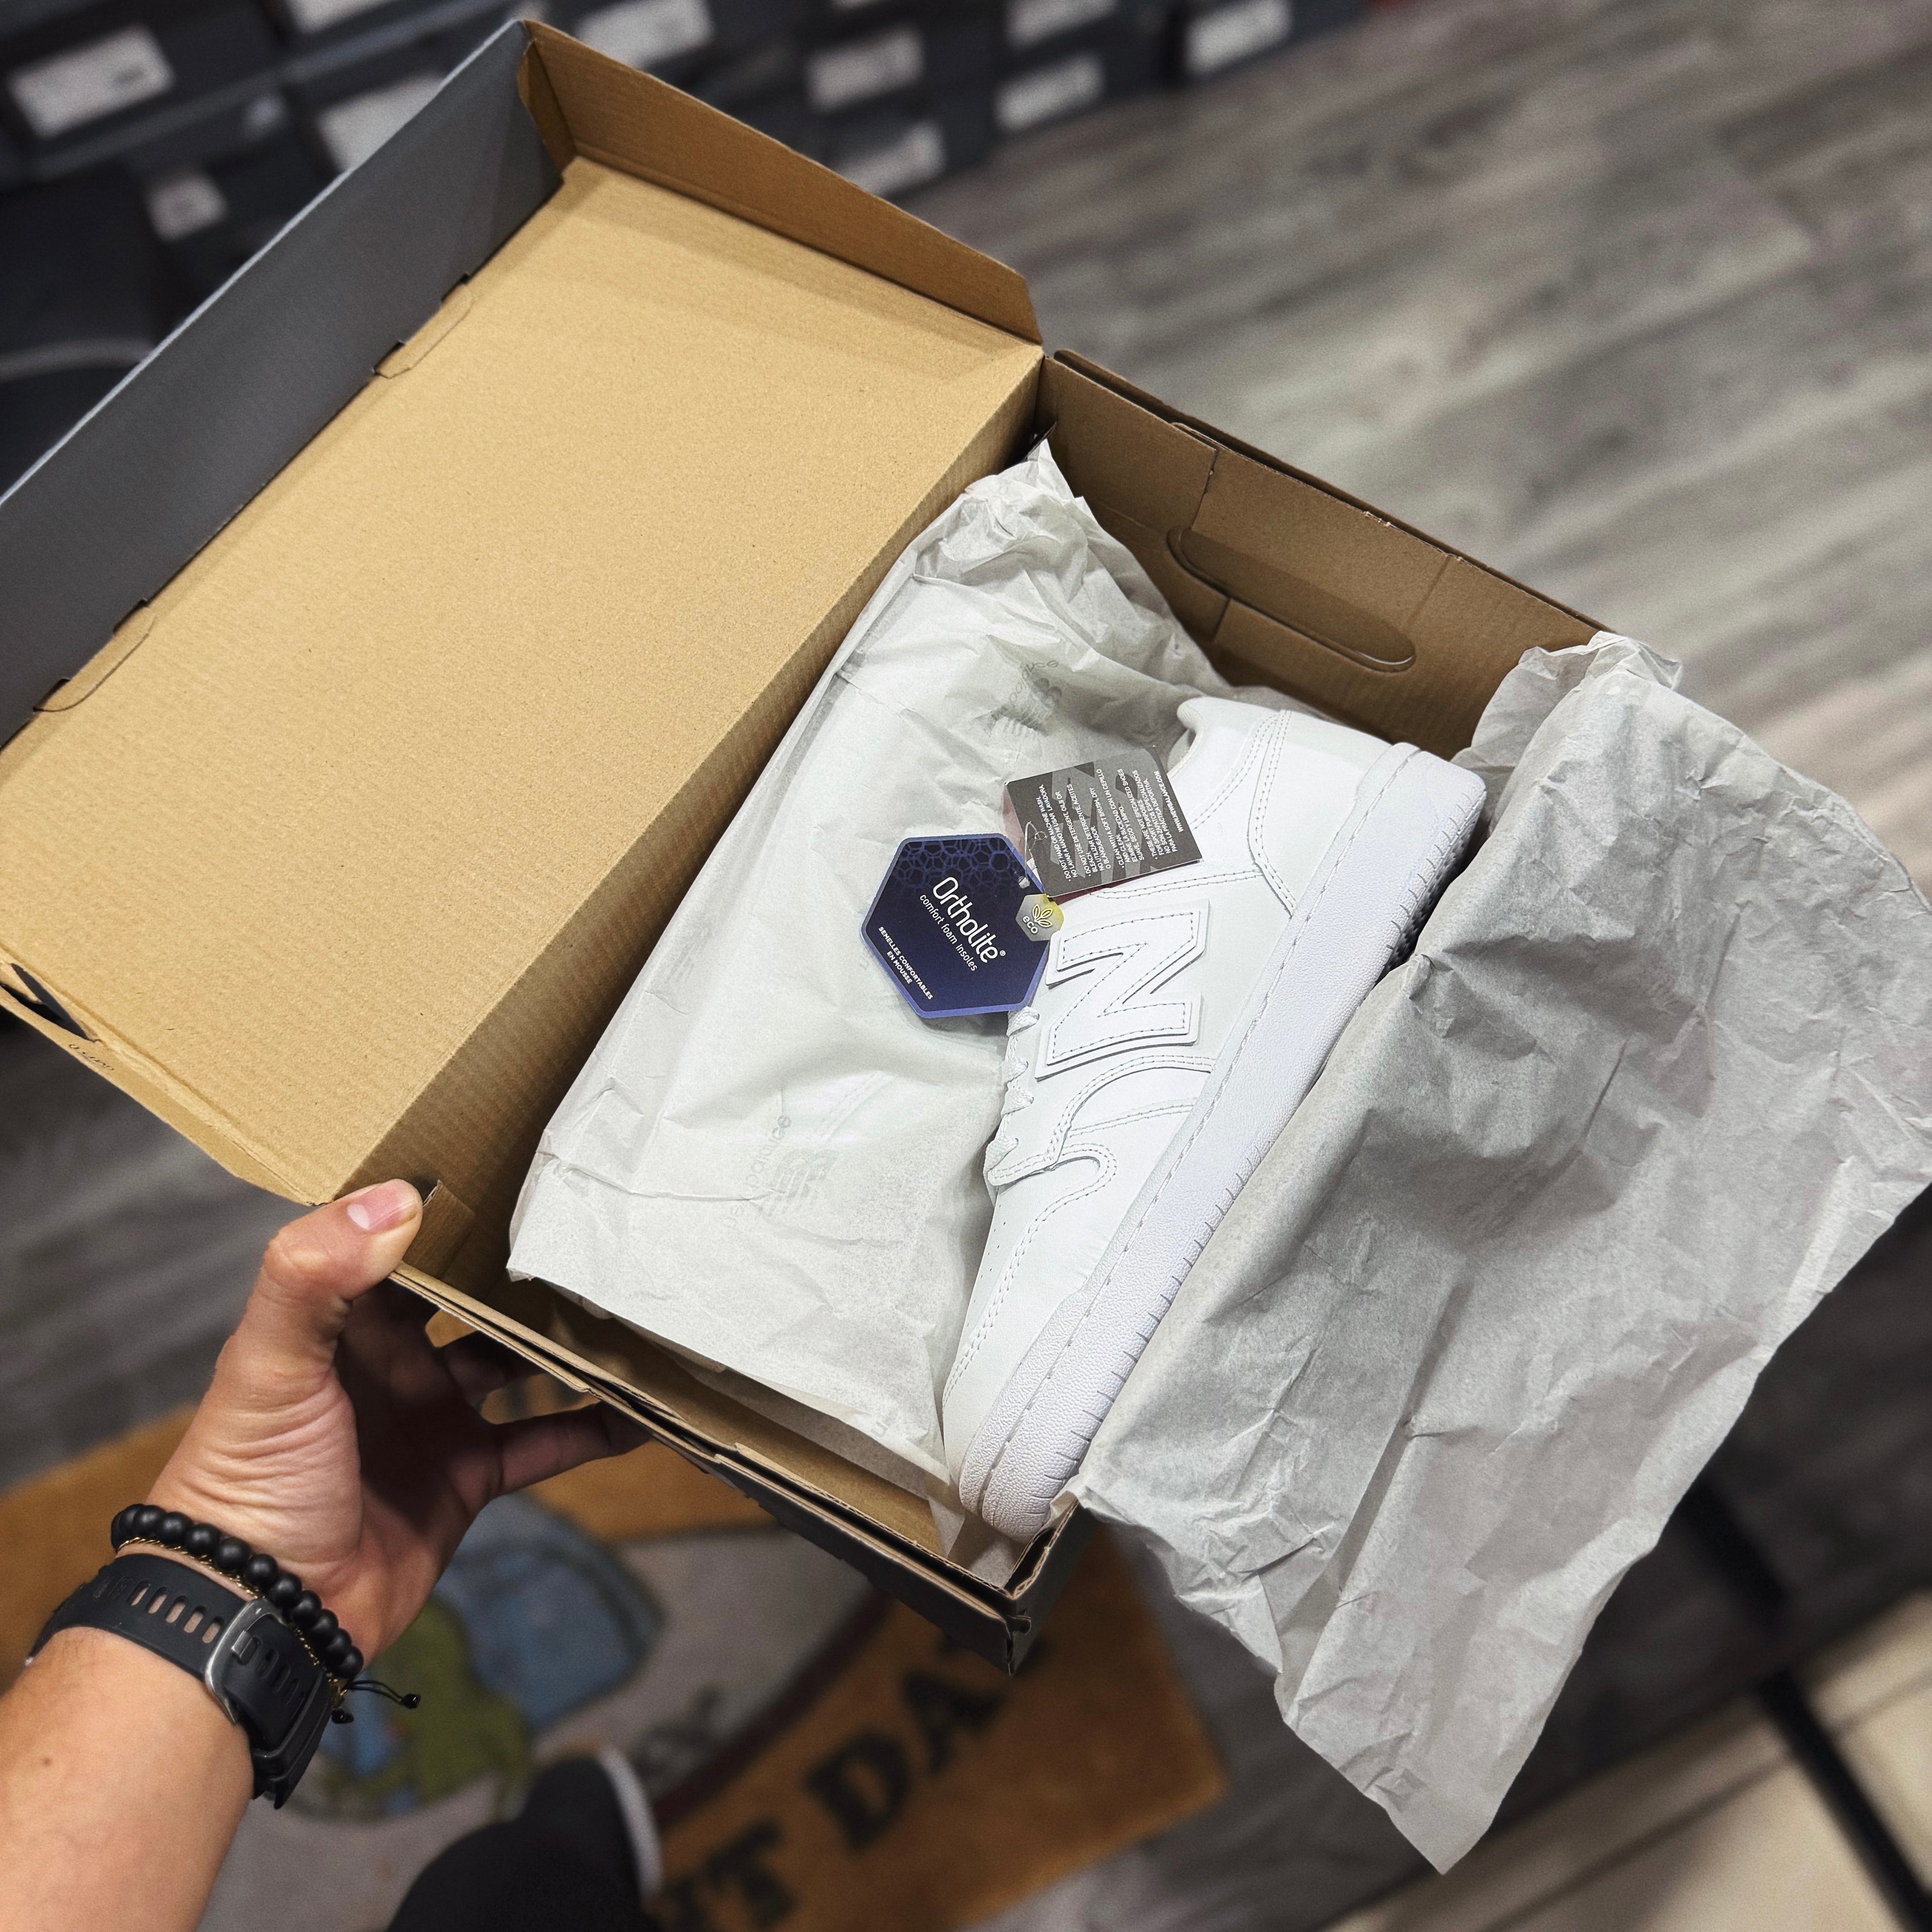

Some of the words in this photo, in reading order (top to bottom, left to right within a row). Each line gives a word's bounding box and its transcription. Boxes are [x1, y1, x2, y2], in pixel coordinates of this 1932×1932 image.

[1096, 769, 1108, 790] CEPILLO
[1117, 768, 1129, 786] SHOES
[1038, 784, 1053, 812] LAVADORA.
[1055, 791, 1063, 799] OR
[1066, 784, 1079, 805] ACEITES
[1089, 787, 1098, 798] DRY
[1104, 789, 1112, 798] UN
[1132, 769, 1154, 812] ESPECIALIZADOS
[1143, 777, 1159, 808] DEPORTIVA.
[1036, 795, 1045, 813] WASH.
[1058, 799, 1067, 812] OILS
[1094, 797, 1105, 817] BRUSH,
[1107, 797, 1116, 810] CON
[1124, 786, 1142, 818] SPECIALIZED
[1041, 812, 1055, 836] MACHINE
[1049, 813, 1059, 827] USAR
[1063, 811, 1079, 843] DETERGENT,
[1100, 818, 1111, 831] SOFT
[1112, 809, 1127, 836] SUCIEDAD
[1137, 818, 1146, 830] NOT
[1149, 811, 1163, 834] ZAPATOS
[1050, 835, 1058, 844] OR
[1057, 833, 1067, 849] MANO
[1108, 835, 1117, 849] WITH
[1122, 835, 1130, 843] LA
[1126, 828, 1137, 843] SECO
[1142, 829, 1151, 840] ARE
[1148, 827, 1160, 844] SPORT
[1158, 834, 1168, 845] SON
[1074, 842, 1084, 854] USE
[1114, 833, 1126, 852] CLEAN.
[1146, 840, 1158, 857] THESE
[1154, 844, 1165, 855] FOR
[1164, 845, 1171, 854] NO
[1168, 838, 1178, 852] PARA
[1054, 844, 1064, 859] HAND
[1088, 840, 1101, 862] UTILIZAR
[1113, 848, 1124, 865] CLEAN
[1122, 852, 1132, 863] AND
[1125, 842, 1139, 863] ELIMINE
[1133, 842, 1145, 861] SUAVE,
[1059, 859, 1068, 870] NOT
[1064, 852, 1075, 869] LAVAR
[1079, 854, 1088, 866] NOT
[1097, 862, 1105, 871] NO
[1064, 870, 1071, 879] DO
[1071, 869, 1078, 878] NO
[1084, 865, 1091, 874] DO
[1023, 916, 1038, 934] eco
[920, 895, 945, 925] comfort
[941, 924, 957, 944] foam
[955, 944, 977, 971] insoles
[878, 926, 901, 955] SEMELLES
[899, 955, 933, 1000] CONFORTABLES
[887, 950, 896, 960] EN
[893, 959, 913, 984] MOUSSE
